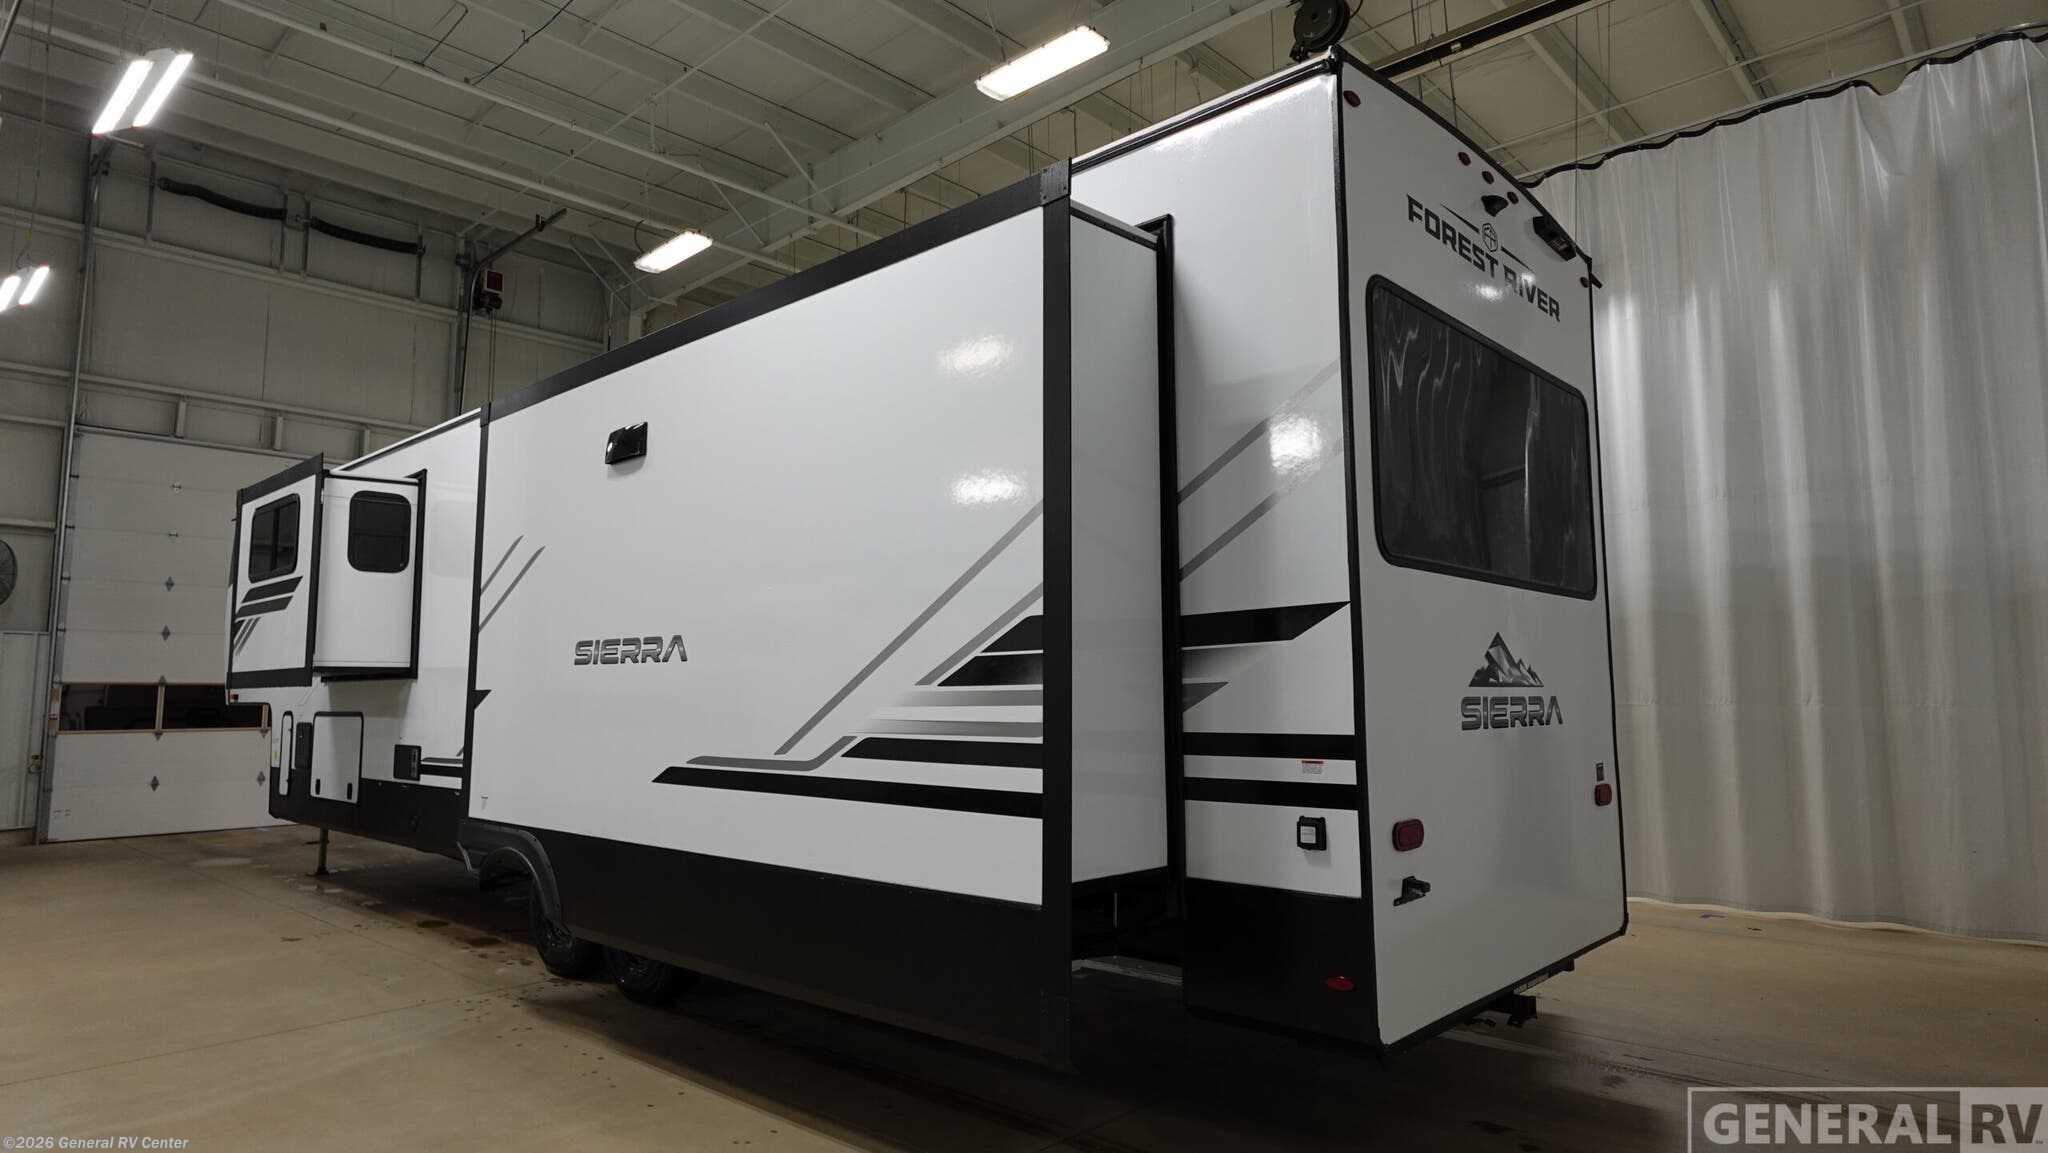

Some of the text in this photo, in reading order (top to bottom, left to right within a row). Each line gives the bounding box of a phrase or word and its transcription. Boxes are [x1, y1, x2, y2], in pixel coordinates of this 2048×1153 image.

[1407, 194, 1560, 322] FOREST RIVER
[574, 635, 688, 665] SIERRA
[1461, 696, 1563, 730] SIERRA
